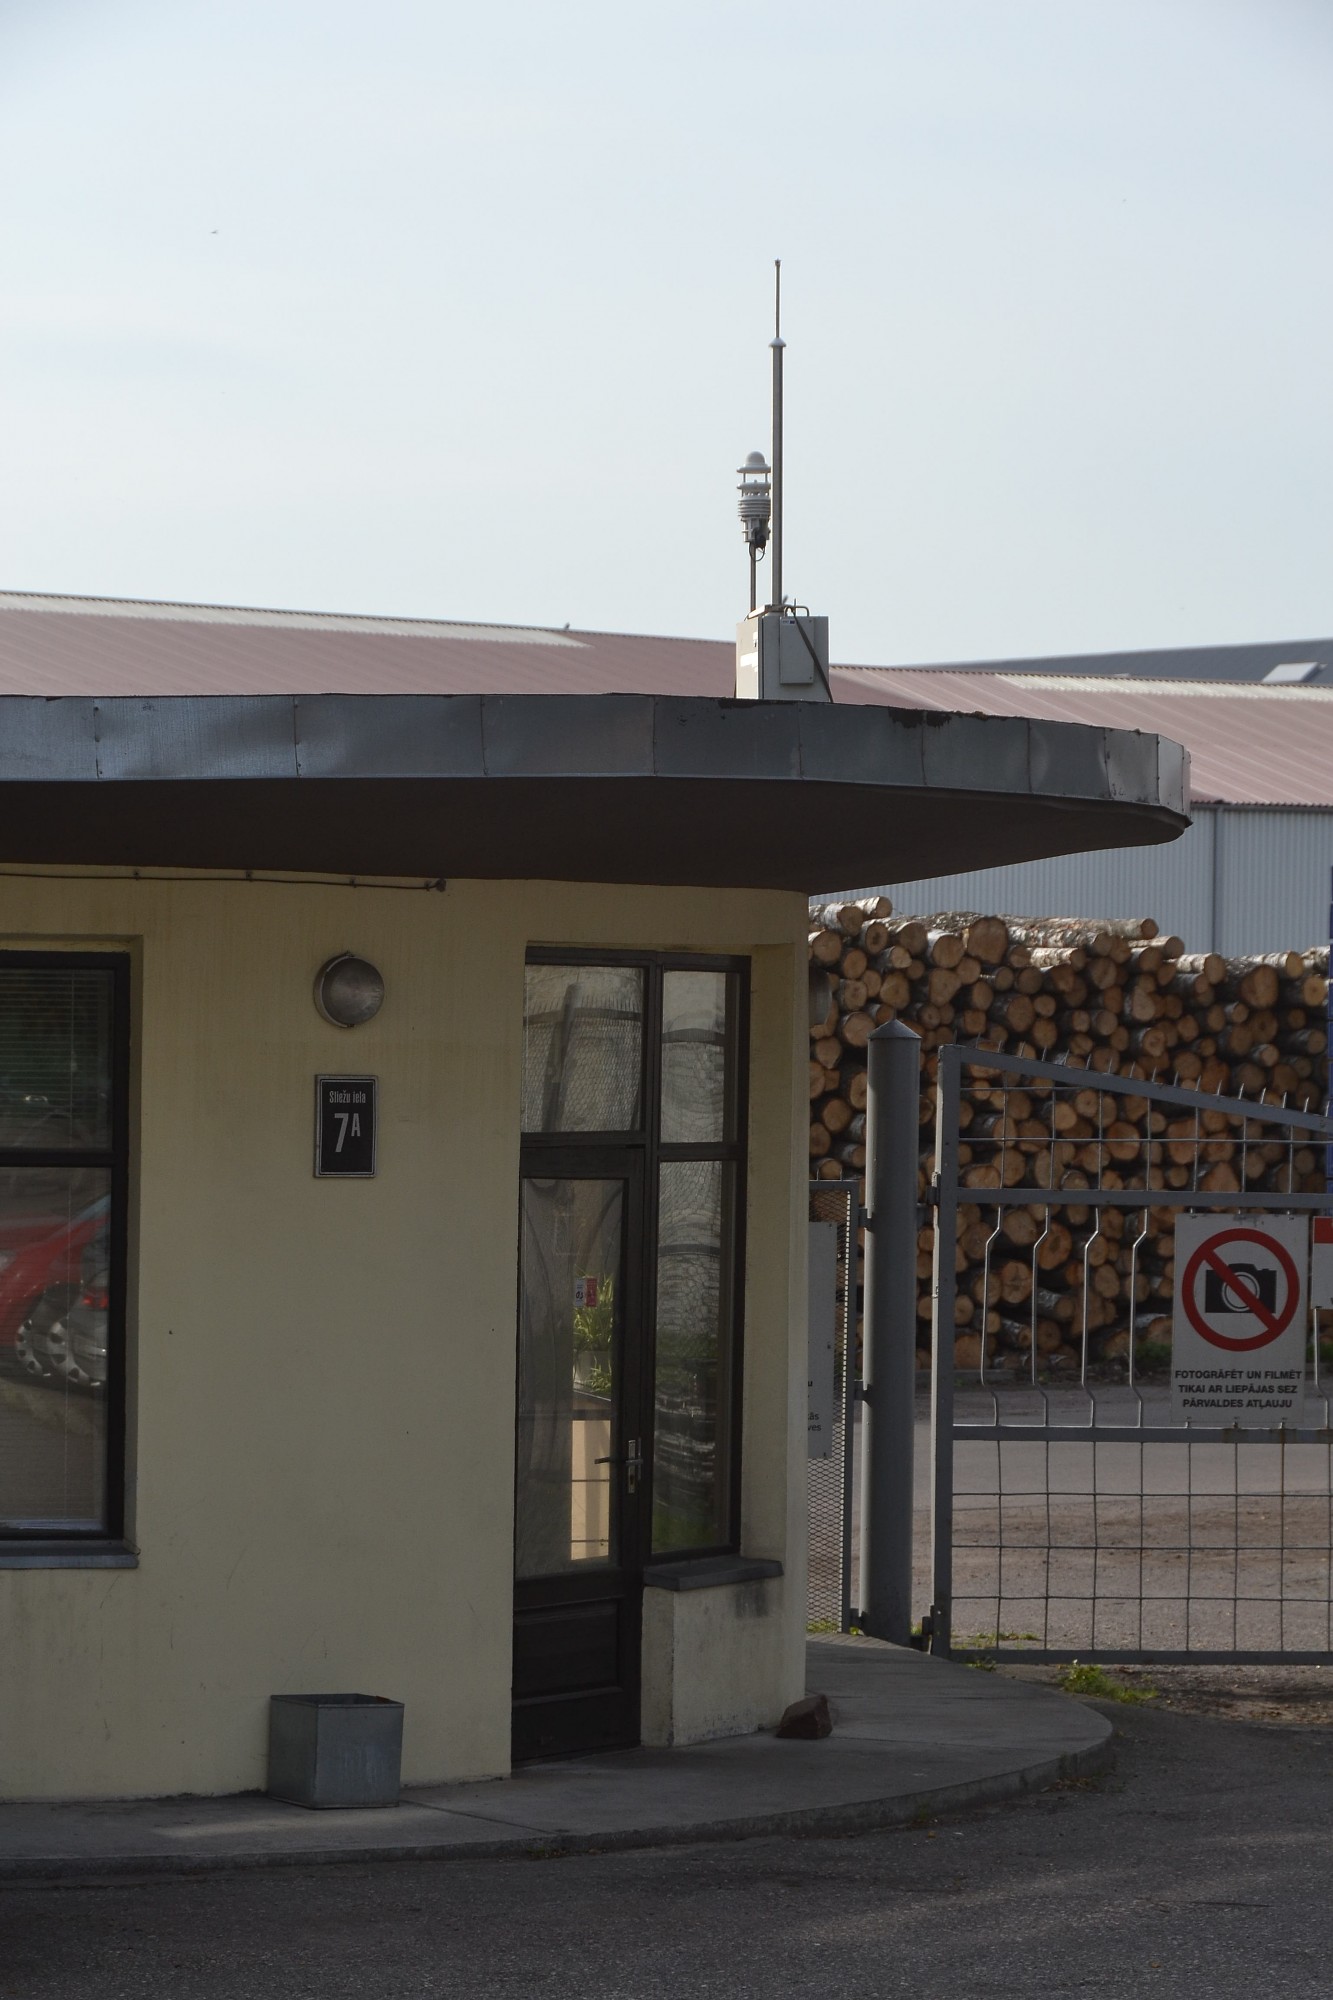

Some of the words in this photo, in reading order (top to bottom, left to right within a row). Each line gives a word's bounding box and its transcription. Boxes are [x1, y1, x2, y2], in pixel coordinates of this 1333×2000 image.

[329, 1090, 351, 1104] Sliežu
[352, 1091, 366, 1104] iela
[1175, 1369, 1244, 1379] FOTOGRĀFĒT
[1247, 1370, 1262, 1379] UN
[1264, 1369, 1303, 1379] FILMĒT
[1178, 1384, 1206, 1393] TIKAI
[1208, 1384, 1223, 1393] AR
[1225, 1383, 1275, 1393] LIEPĀJAS
[1277, 1384, 1298, 1393] SEZ
[1182, 1397, 1244, 1408] PĀRVALDES
[1246, 1399, 1293, 1410] ATĻAUJU
